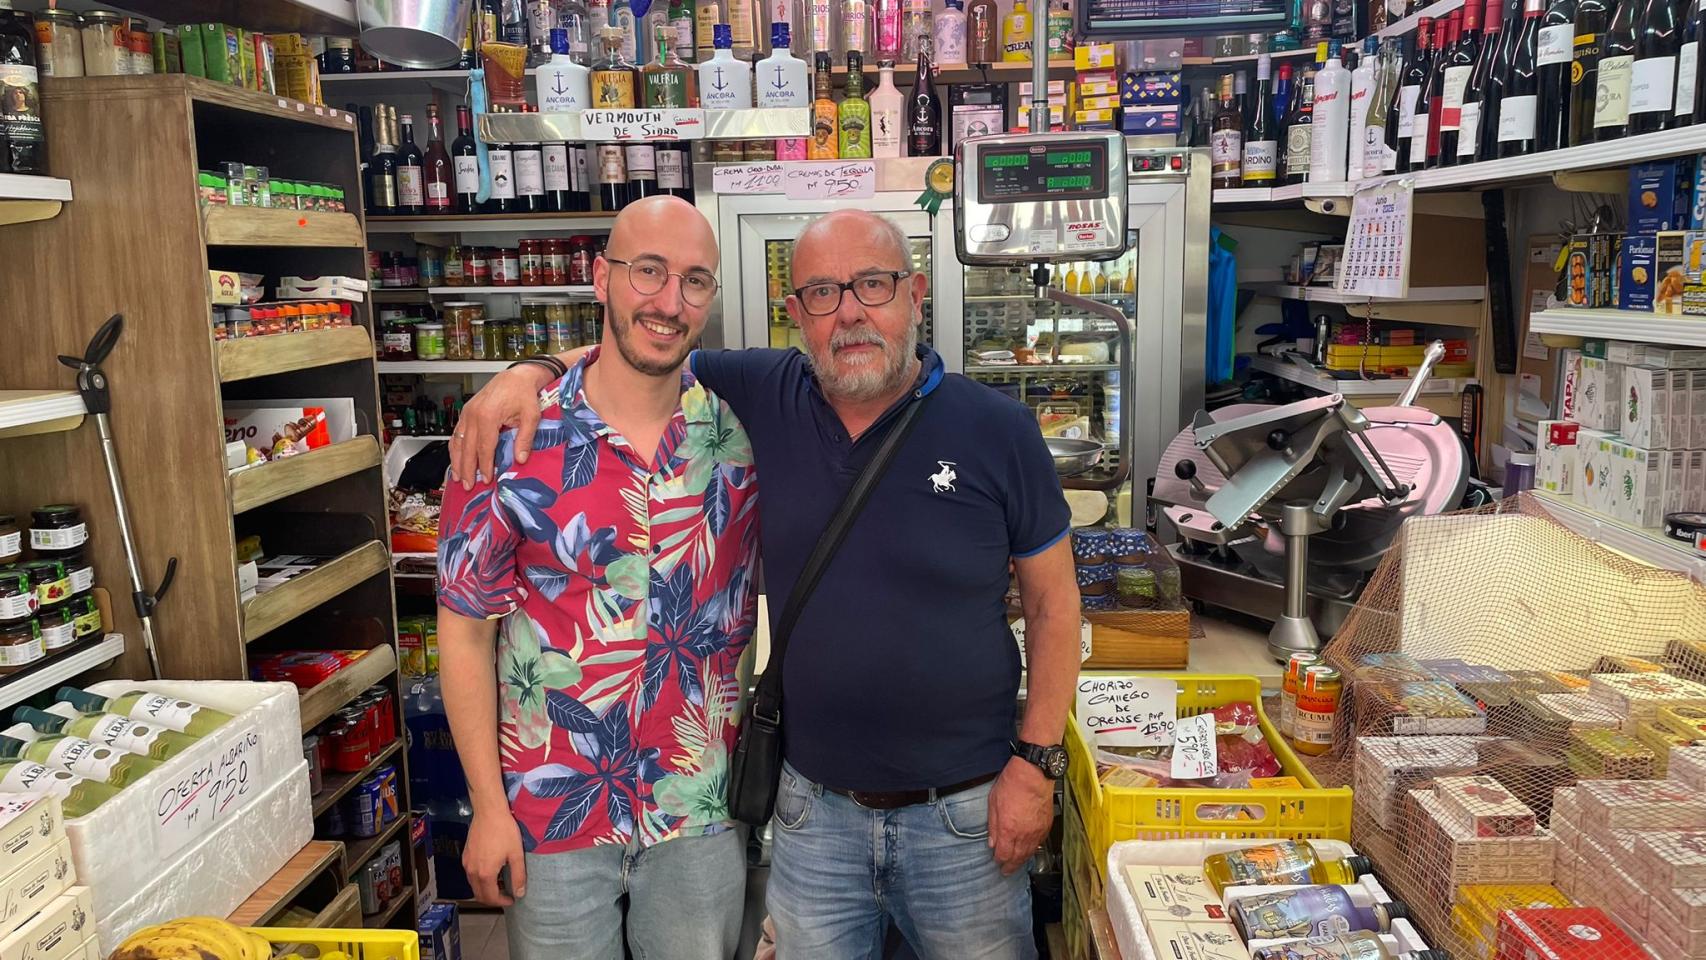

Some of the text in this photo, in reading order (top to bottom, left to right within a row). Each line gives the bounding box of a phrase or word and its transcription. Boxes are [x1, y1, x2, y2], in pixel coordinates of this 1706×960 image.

[1006, 41, 1032, 53] CREA
[649, 73, 679, 85] VALERIA
[585, 112, 661, 125] VERMOUTH
[614, 127, 629, 137] DE
[1067, 222, 1101, 230] ROSAS
[1079, 680, 1133, 692] CHORIZO
[1115, 704, 1130, 713] DE
[1086, 713, 1143, 727] ORENSE
[1296, 709, 1332, 721] RCUMA
[158, 732, 258, 817] OFERTA ALBARIÑO
